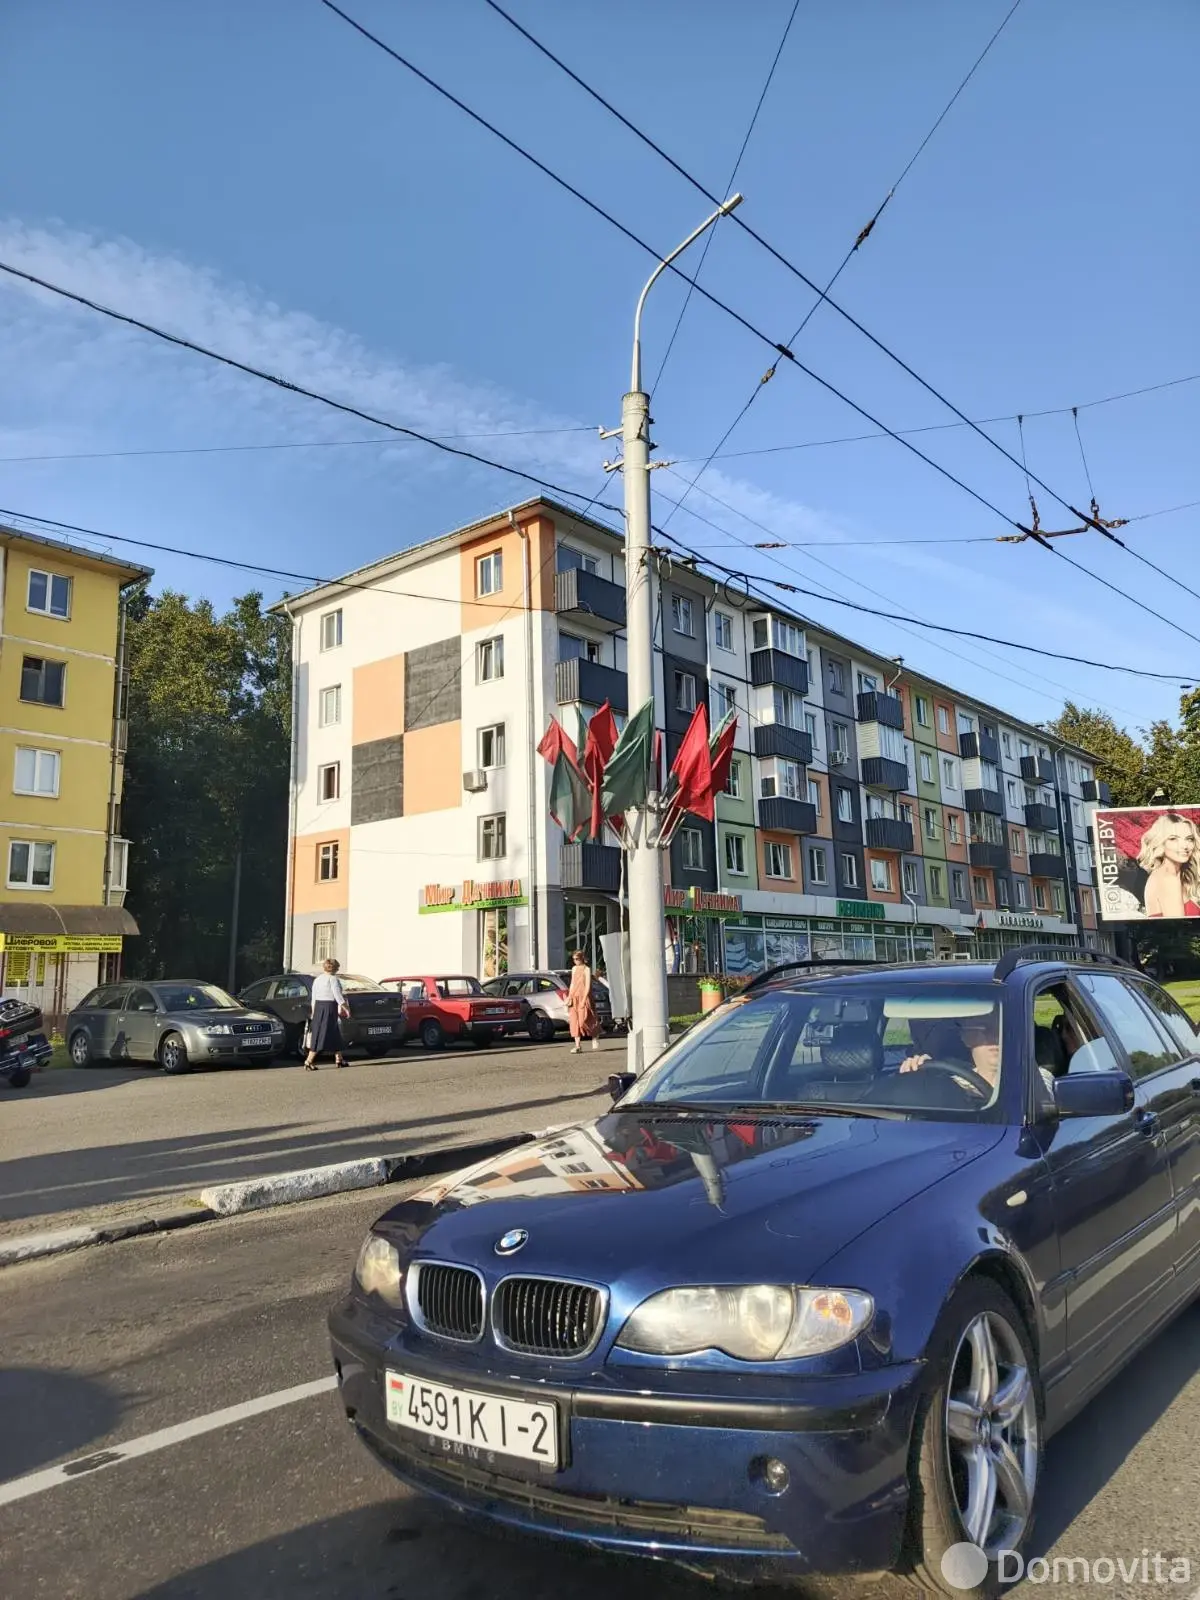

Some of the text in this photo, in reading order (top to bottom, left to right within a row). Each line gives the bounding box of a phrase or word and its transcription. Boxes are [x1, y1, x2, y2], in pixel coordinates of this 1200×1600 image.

[1099, 818, 1121, 914] FONBET.BY
[5, 935, 57, 946] ЦИФРОВОЙ
[391, 1400, 404, 1419] BY
[441, 1440, 480, 1460] BMW
